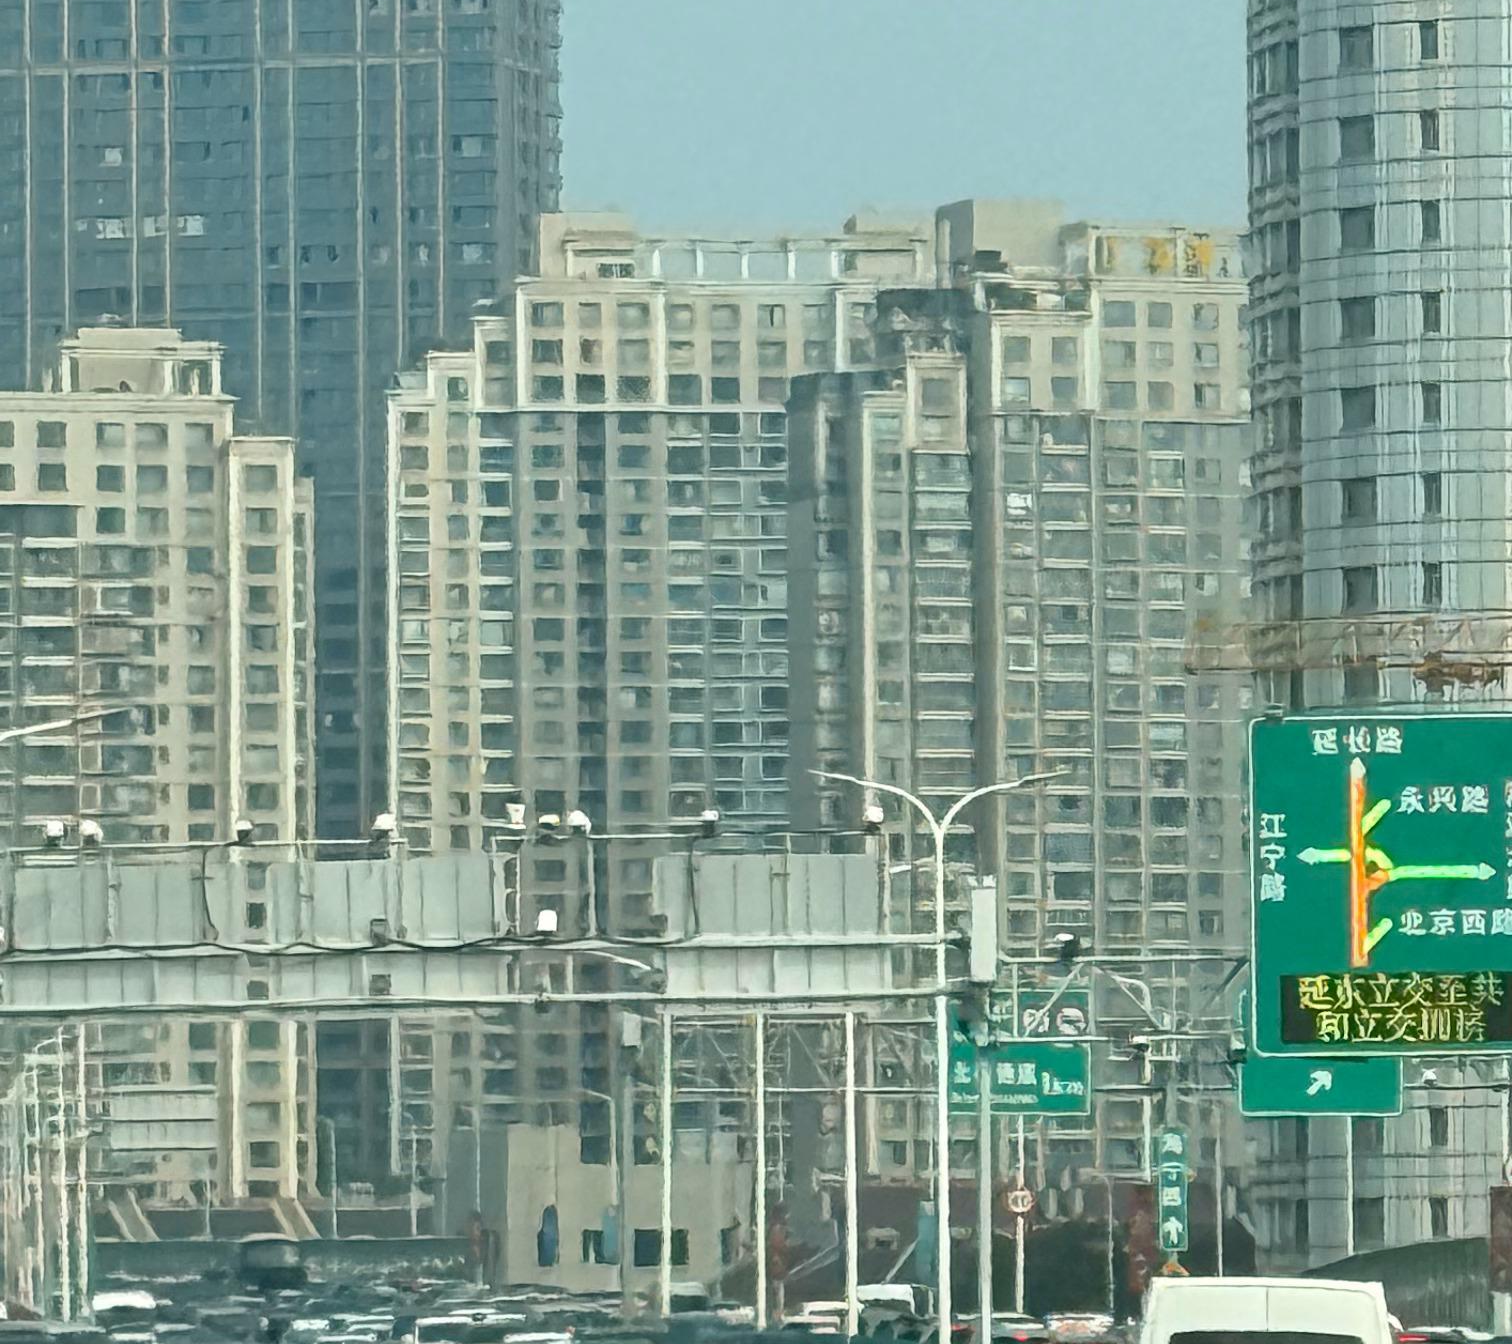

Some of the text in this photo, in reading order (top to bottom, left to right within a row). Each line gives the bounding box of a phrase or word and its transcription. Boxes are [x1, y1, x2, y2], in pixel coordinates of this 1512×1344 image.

[1311, 726, 1402, 755] 延长路
[1396, 785, 1489, 814] 永兴路
[1259, 813, 1288, 902] 江宁路
